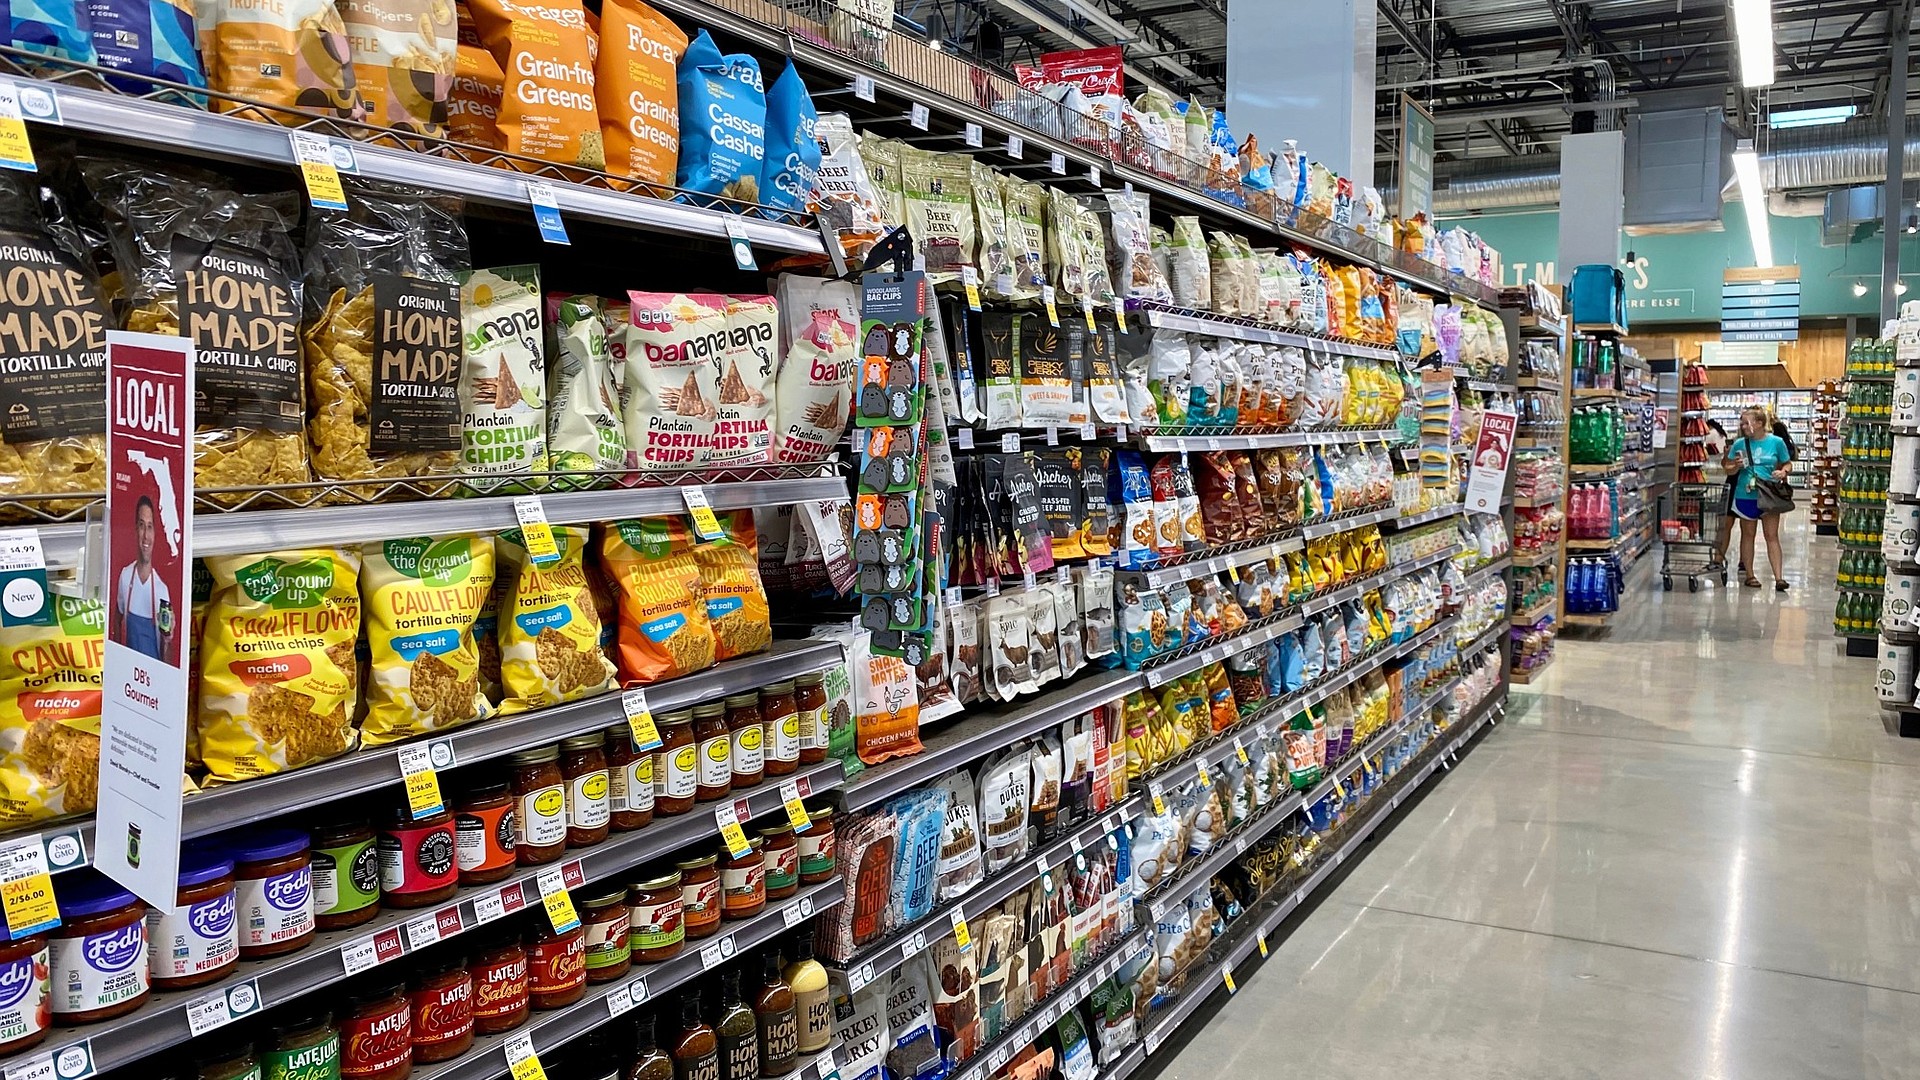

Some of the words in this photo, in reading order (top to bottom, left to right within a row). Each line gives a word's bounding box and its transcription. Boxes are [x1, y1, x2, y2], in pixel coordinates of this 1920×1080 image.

[363, 4, 413, 22] dippers
[517, 80, 593, 111] Greens
[630, 116, 677, 153] Greens
[521, 146, 533, 154] Sea
[926, 210, 951, 221] BEEF
[926, 220, 958, 233] JERKY
[202, 256, 270, 281] ORIGINAL
[186, 270, 293, 317] HOME
[866, 293, 881, 301] BAG
[883, 292, 901, 300] CLIPS
[399, 295, 448, 313] ORIGINAL
[1651, 298, 1681, 307] ELSE
[0, 309, 106, 353] MADE
[190, 312, 298, 355] MADE
[382, 310, 460, 348] HOME
[0, 353, 77, 374] TORTILLA
[80, 351, 106, 368] CHIP
[267, 358, 297, 374] CHIPS
[381, 350, 460, 383] MADE
[1028, 360, 1064, 368] PERKY
[1028, 366, 1064, 376] JERKY
[380, 383, 438, 398] TORTILLA
[115, 377, 180, 436] LOCAL
[463, 412, 514, 428] Plantain
[650, 416, 692, 432] Plantain
[1484, 418, 1512, 432] LOCAL
[789, 425, 823, 441] Plantain
[465, 445, 526, 463] CHIPS
[644, 448, 694, 462] CHIPS
[527, 533, 545, 541] $3.49
[10, 545, 35, 553] $4.99
[389, 543, 421, 555] from
[391, 555, 416, 569] the
[422, 551, 471, 572] ground
[246, 571, 274, 589] from
[278, 572, 332, 592] ground
[433, 568, 452, 582] up
[253, 584, 279, 596] the
[287, 589, 308, 604] up
[635, 580, 685, 606] SQUASH
[733, 584, 754, 594] chips
[12, 593, 35, 603] New
[718, 601, 733, 610] salt
[641, 603, 671, 617] tortilla
[672, 599, 691, 613] chips
[395, 615, 442, 629] tortilla
[445, 613, 472, 626] chips
[525, 617, 545, 626] sea
[546, 612, 563, 623] salt
[649, 623, 663, 633] sea
[664, 619, 679, 630] salt
[1000, 620, 1018, 633] EPIC
[234, 640, 286, 653] tortilla
[288, 637, 325, 651] chips
[401, 640, 423, 649] sea
[425, 637, 447, 648] salt
[248, 662, 289, 673] nacho
[825, 665, 847, 685] SNACK
[23, 670, 88, 688] tortilla
[133, 666, 151, 687] DB's
[35, 697, 80, 708] nacho
[124, 683, 159, 710] Gourmet
[866, 734, 895, 746] CHICKEN
[900, 728, 916, 738] MAPLE
[411, 782, 433, 793] 2/$6.00
[1000, 784, 1025, 805] DUKES
[55, 842, 71, 851] Non
[55, 848, 75, 859] GMO
[14, 851, 38, 863] $3.99
[428, 862, 451, 874] SALSA
[563, 868, 580, 881] LOCAL
[3, 881, 34, 896] SALE
[268, 870, 310, 900] Fody
[9, 890, 45, 906] 2/$6.00
[503, 892, 521, 905] LOCAL
[194, 897, 235, 926] Fody
[548, 901, 565, 912] $3.99
[271, 927, 298, 940] MEDIUM
[300, 920, 315, 935] SALSA
[420, 923, 435, 934] $5.99
[439, 915, 458, 928] LOCAL
[1158, 922, 1184, 935] Pita
[88, 926, 141, 958] Fody
[356, 947, 373, 958] $5.99
[377, 938, 399, 953] LOCAL
[195, 954, 224, 971] MEDIUM
[103, 984, 114, 992] NO
[115, 976, 137, 988] GARLIC
[104, 978, 115, 986] NO
[116, 971, 136, 983] ONION
[98, 991, 118, 1005] MILD
[120, 982, 141, 999] SALSA
[234, 996, 251, 1007] GMO
[235, 991, 248, 1000] Non
[477, 980, 524, 1007] Salsa
[204, 1002, 224, 1014] $5.49
[1, 1025, 28, 1039] SALSA
[900, 1027, 926, 1044] ORIGINAL
[27, 1066, 50, 1080] $5.49
